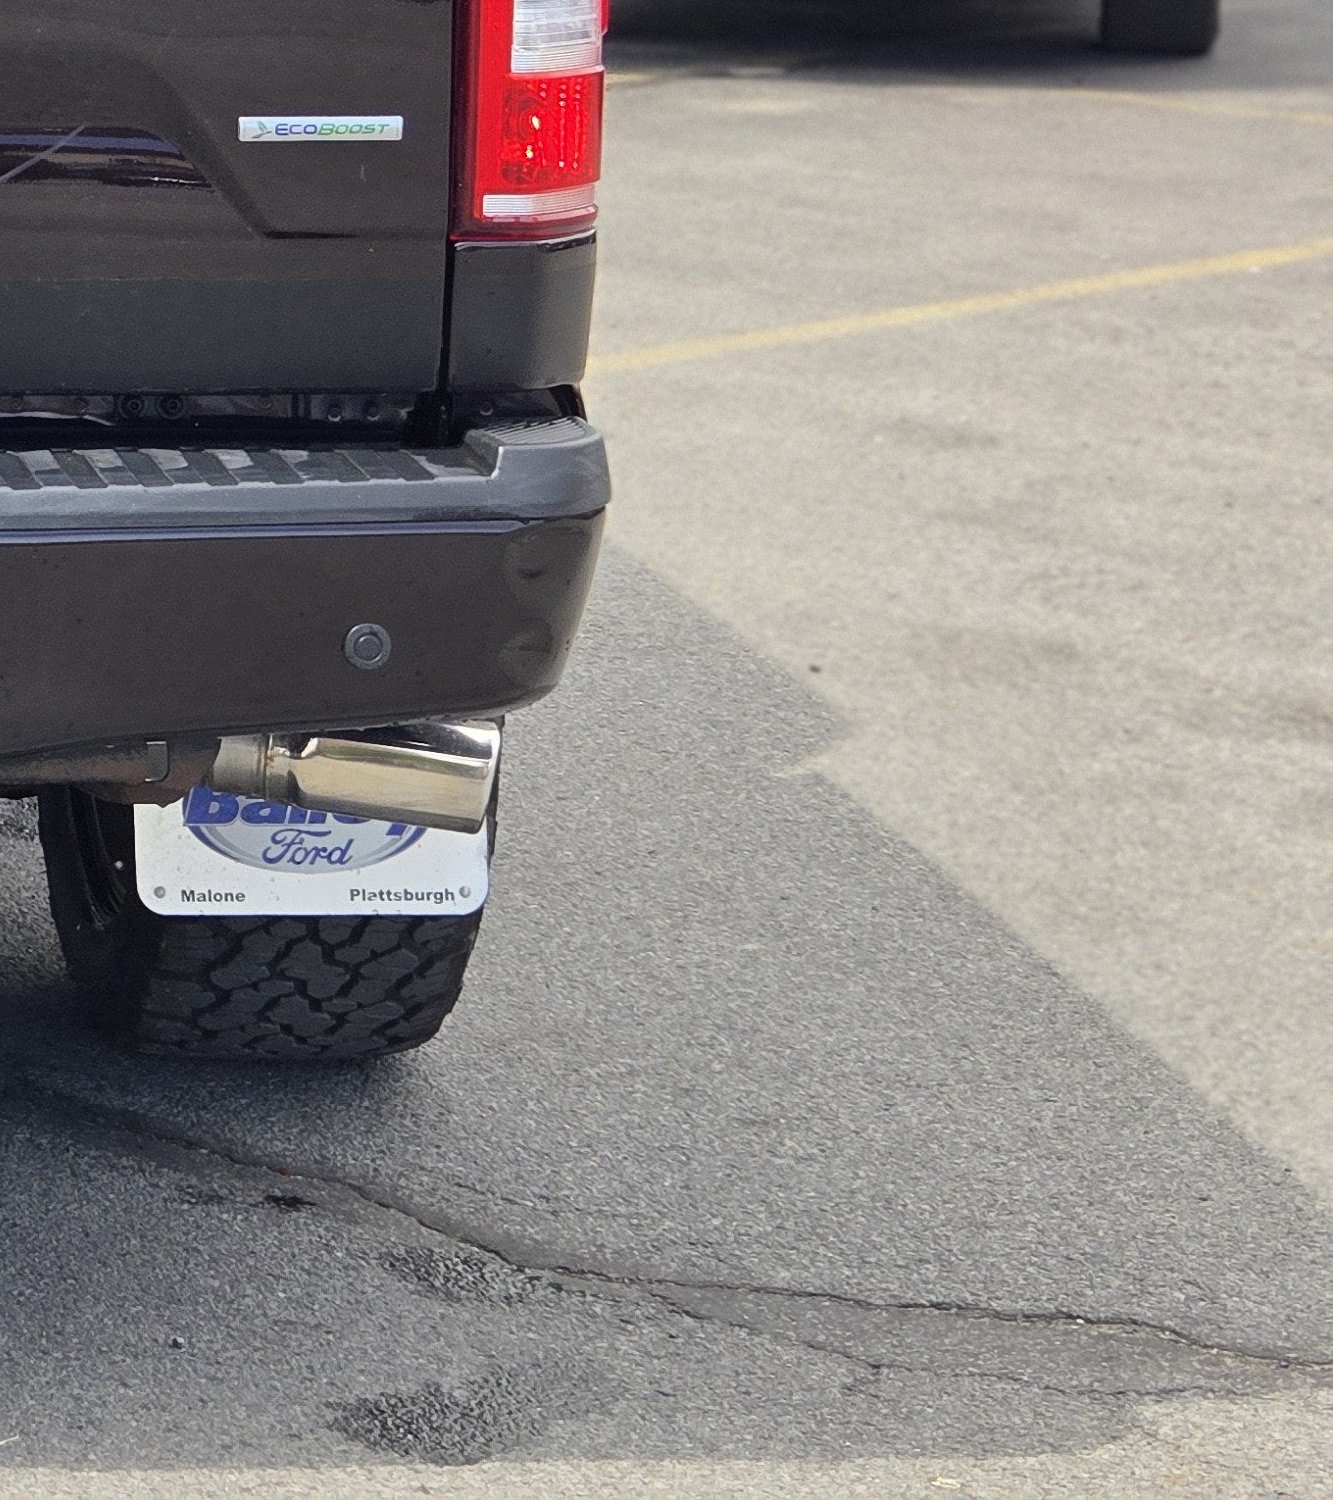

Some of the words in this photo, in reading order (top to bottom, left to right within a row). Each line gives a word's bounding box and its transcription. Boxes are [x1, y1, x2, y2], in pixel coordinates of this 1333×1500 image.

[262, 828, 354, 866] Ford
[181, 888, 247, 903] Malone
[349, 888, 456, 905] Plattsburgh
